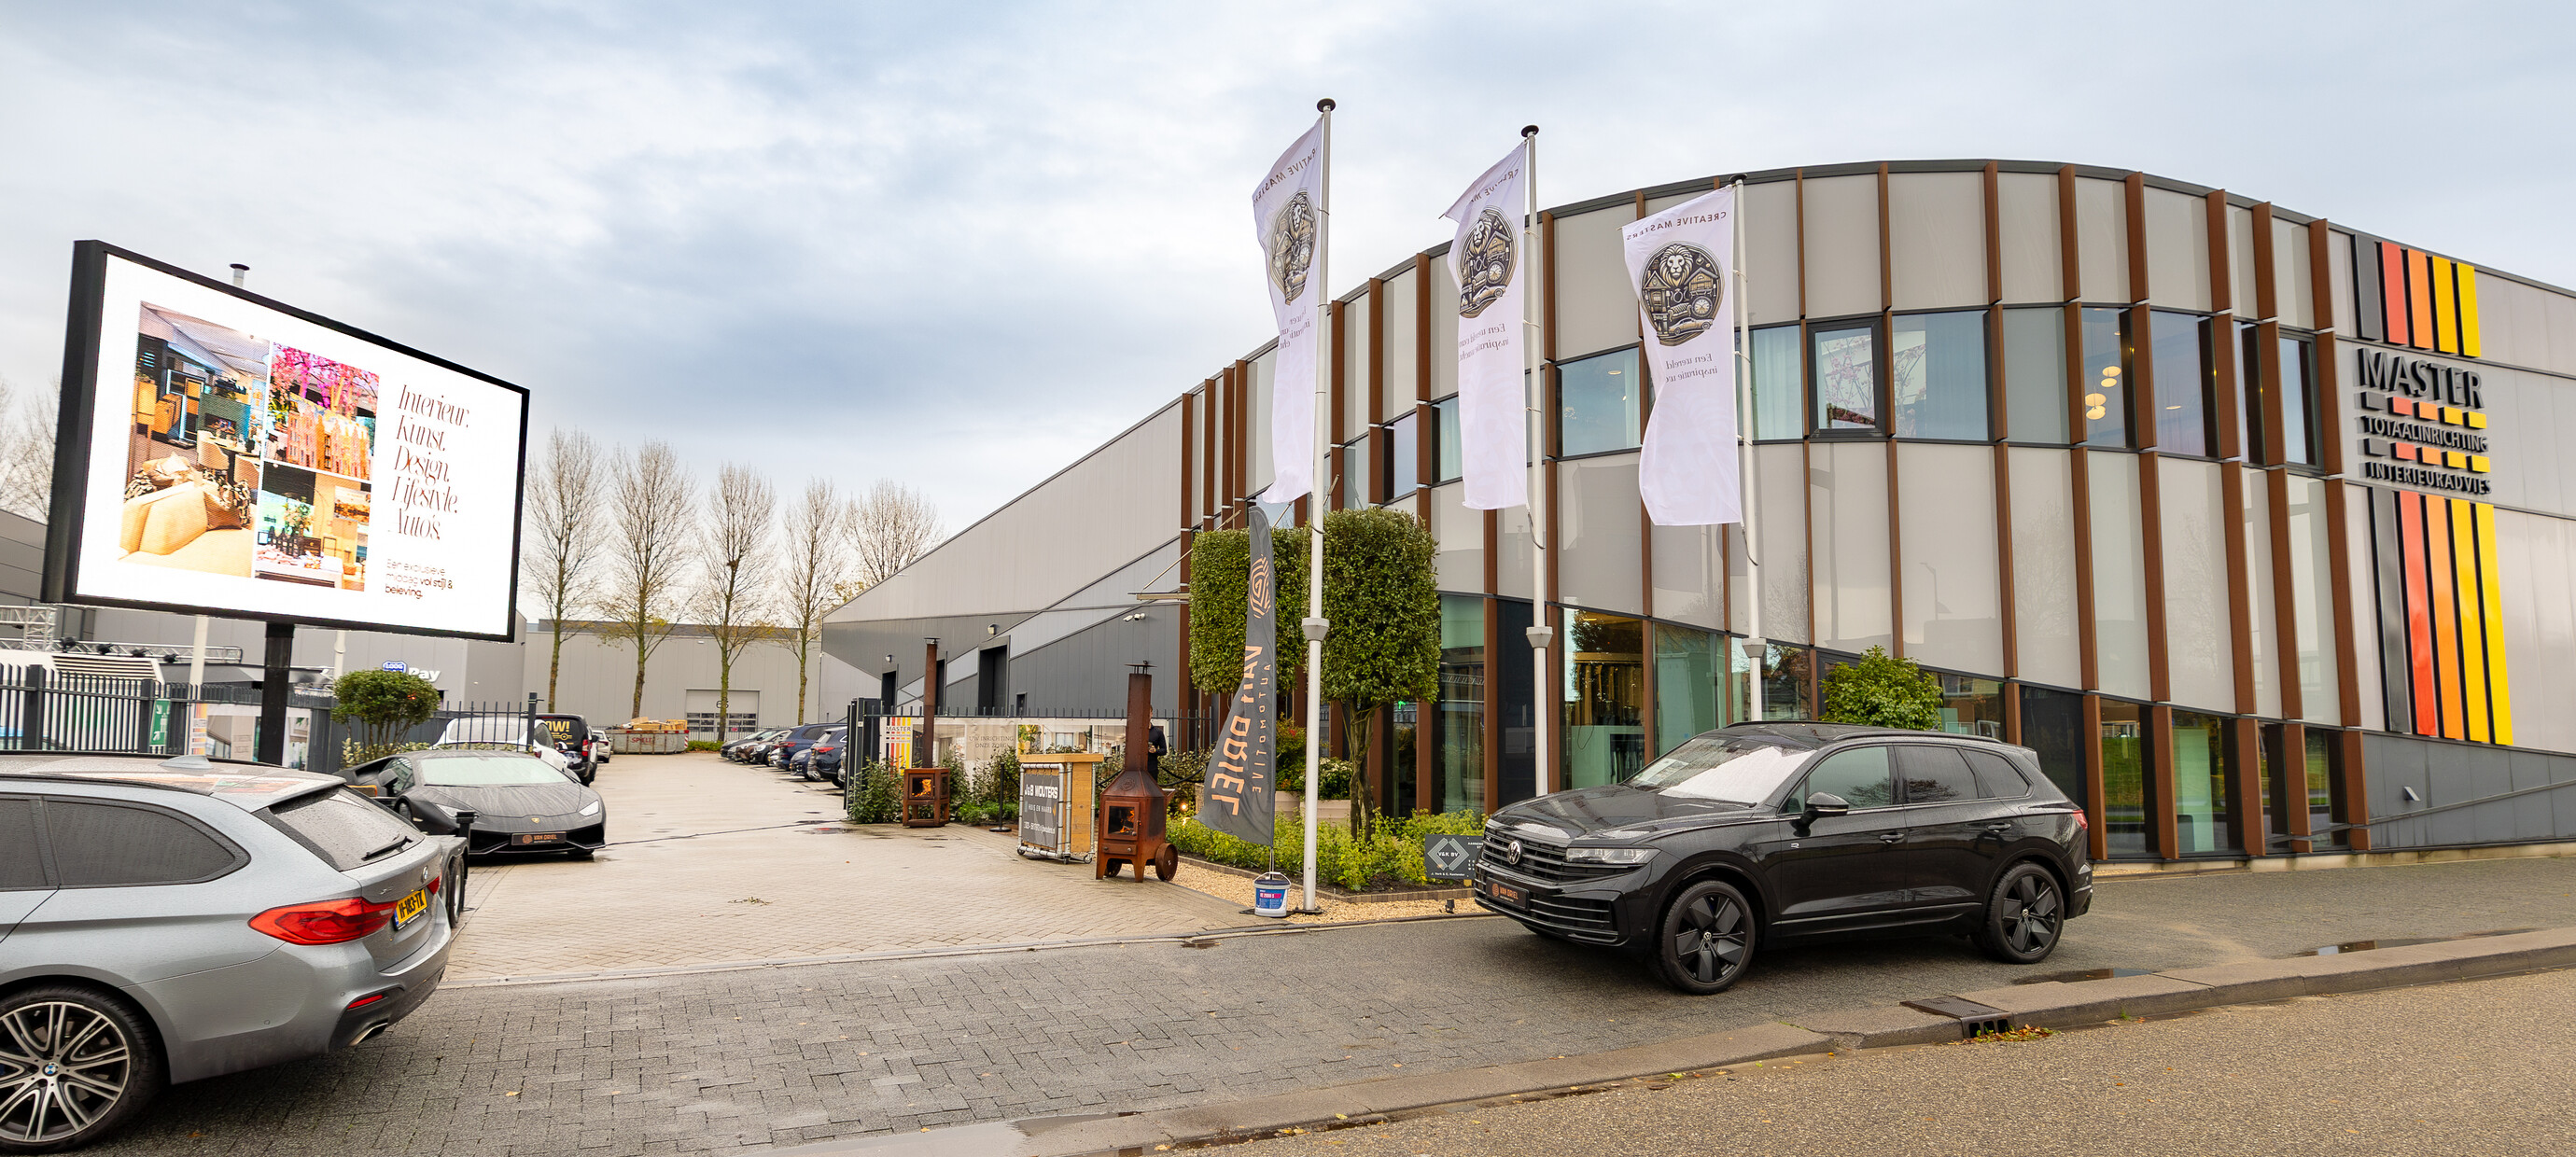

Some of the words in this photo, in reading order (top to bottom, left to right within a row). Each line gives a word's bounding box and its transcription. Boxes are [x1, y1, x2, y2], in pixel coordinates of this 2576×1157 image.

[2358, 348, 2485, 409] MASTER
[399, 383, 470, 428] Interieur.
[2360, 415, 2488, 453] TOTAALINRICHTING
[394, 445, 450, 487] Design.
[2364, 461, 2492, 495] INTERIEURADVIES
[408, 667, 441, 683] Pay
[1034, 785, 1058, 800] WOUTERS
